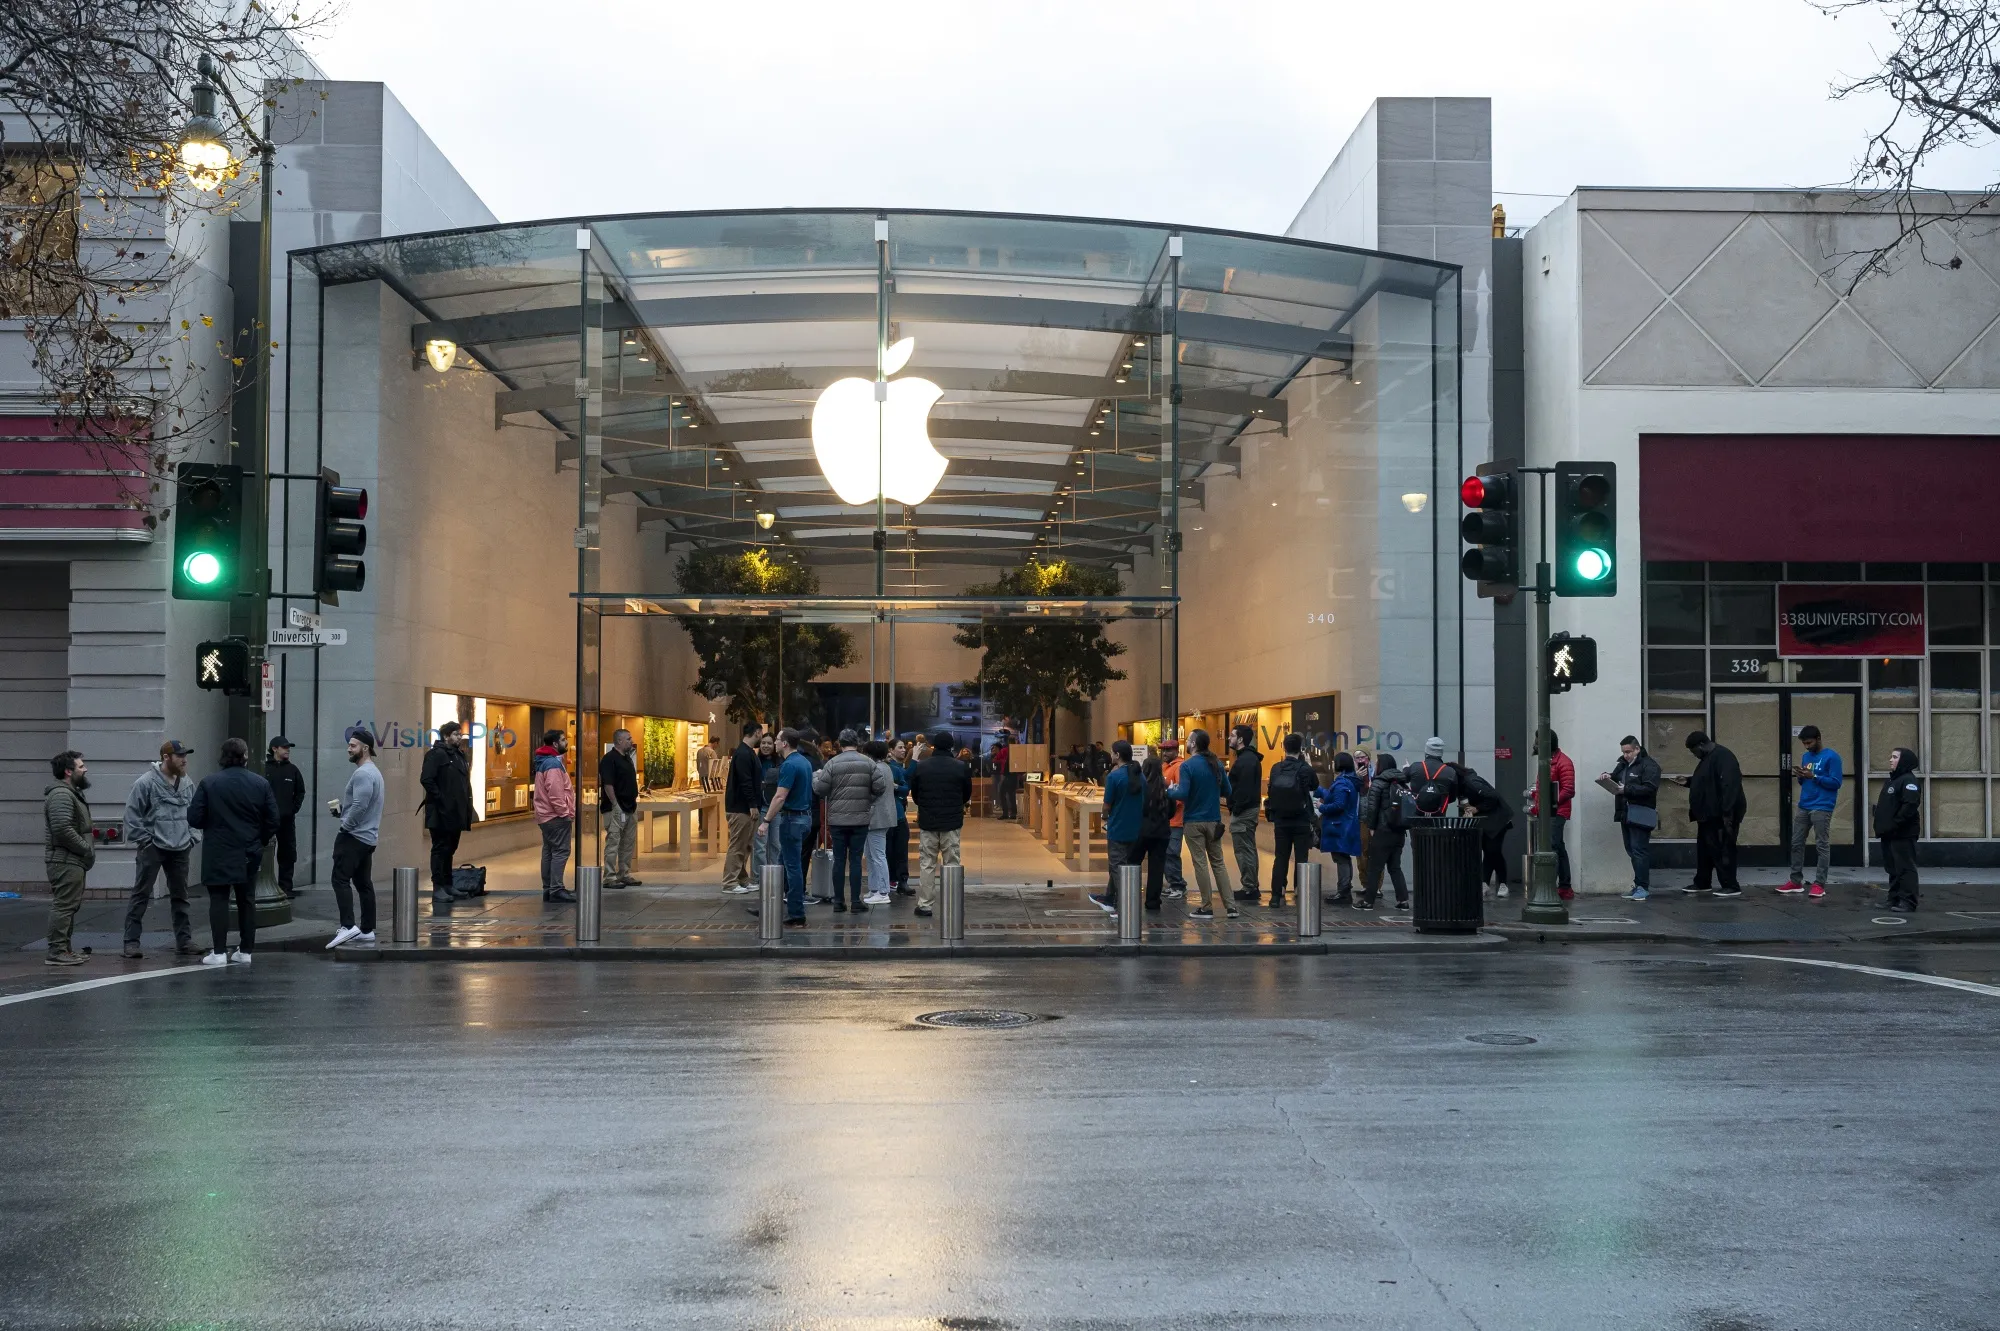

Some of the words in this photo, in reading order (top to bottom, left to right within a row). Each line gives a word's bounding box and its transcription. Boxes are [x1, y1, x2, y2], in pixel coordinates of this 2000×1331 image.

[1307, 613, 1335, 624] 340
[1780, 612, 1923, 626] 338UNIVERSITY.COM
[272, 631, 321, 644] University
[1731, 658, 1760, 673] 338
[370, 721, 441, 749] Visio
[469, 722, 517, 749] Pro
[1261, 725, 1349, 750] Vion
[1357, 725, 1404, 751] Pro
